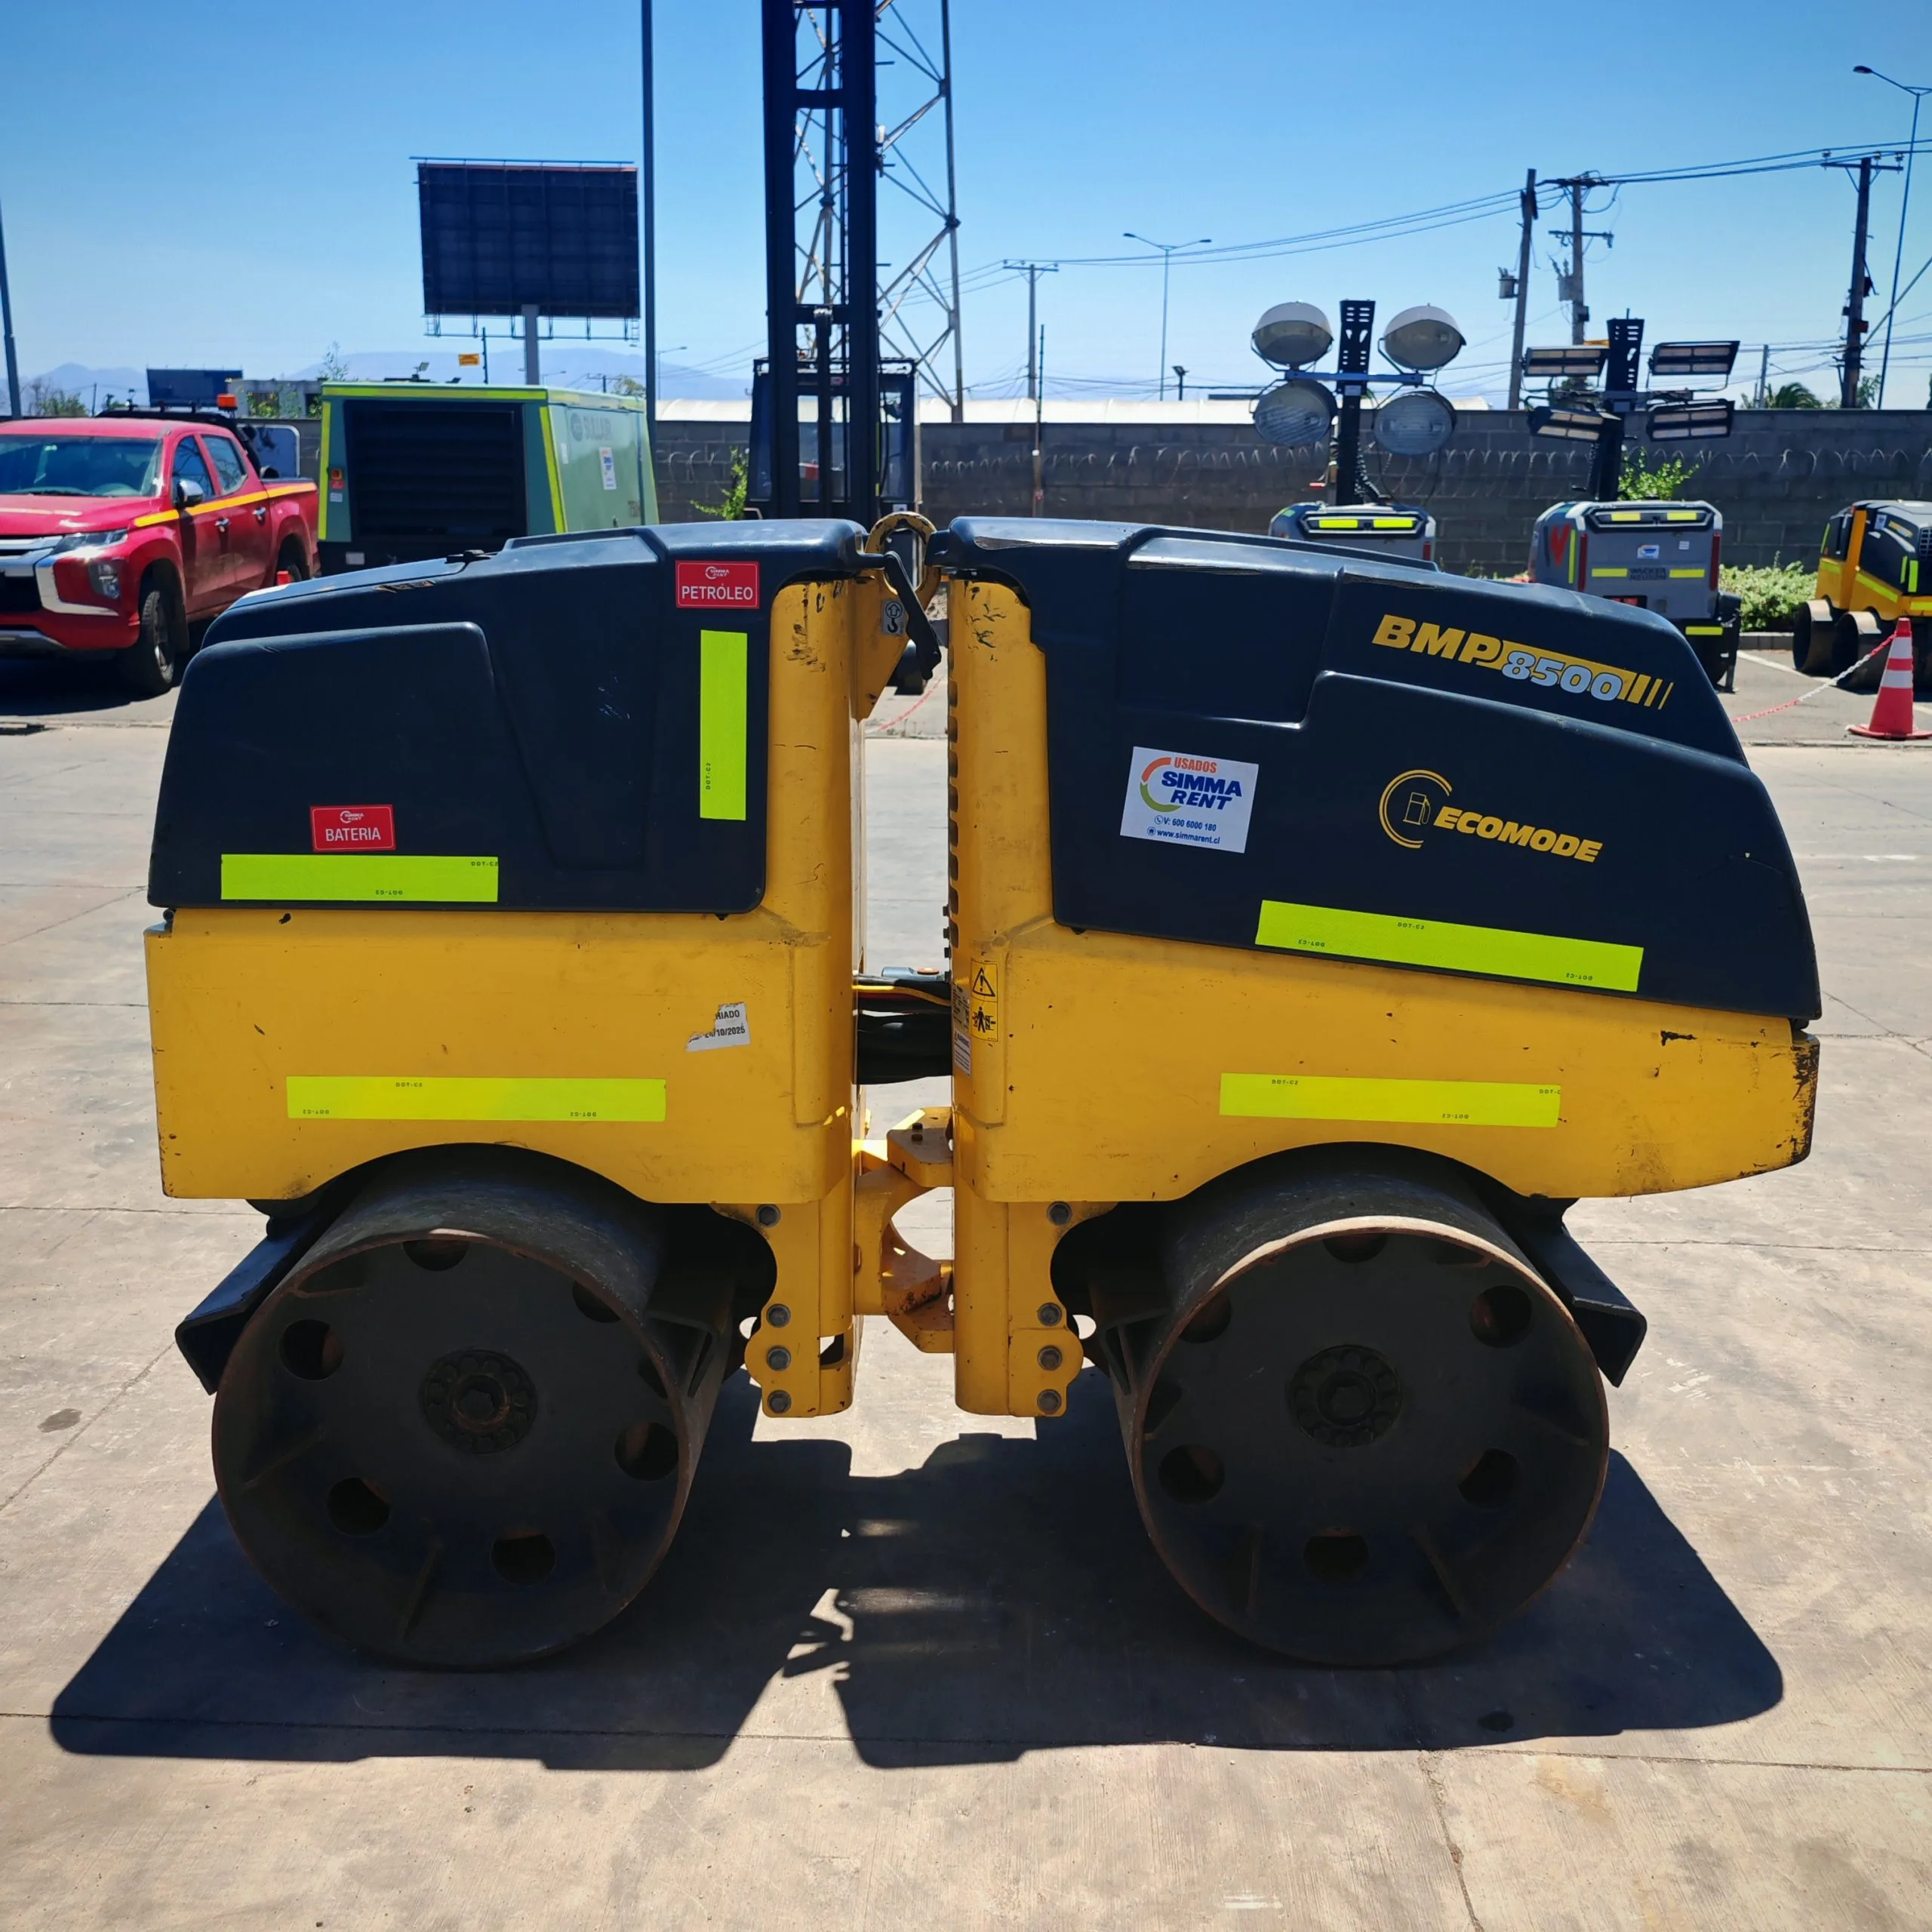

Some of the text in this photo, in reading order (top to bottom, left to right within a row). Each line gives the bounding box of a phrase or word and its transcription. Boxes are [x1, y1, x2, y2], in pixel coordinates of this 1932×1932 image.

[681, 583, 753, 600] PETRÓLEO
[1174, 757, 1217, 774] USADOS
[1161, 771, 1242, 797] SIMMA
[1170, 789, 1232, 810] RENT
[1172, 818, 1185, 827] 600
[1186, 820, 1202, 830] 6000
[1204, 823, 1217, 832] 180
[325, 827, 381, 841] BATERIA
[1156, 829, 1220, 844] www.simmarent.cl
[1433, 805, 1603, 863] ECOMODE
